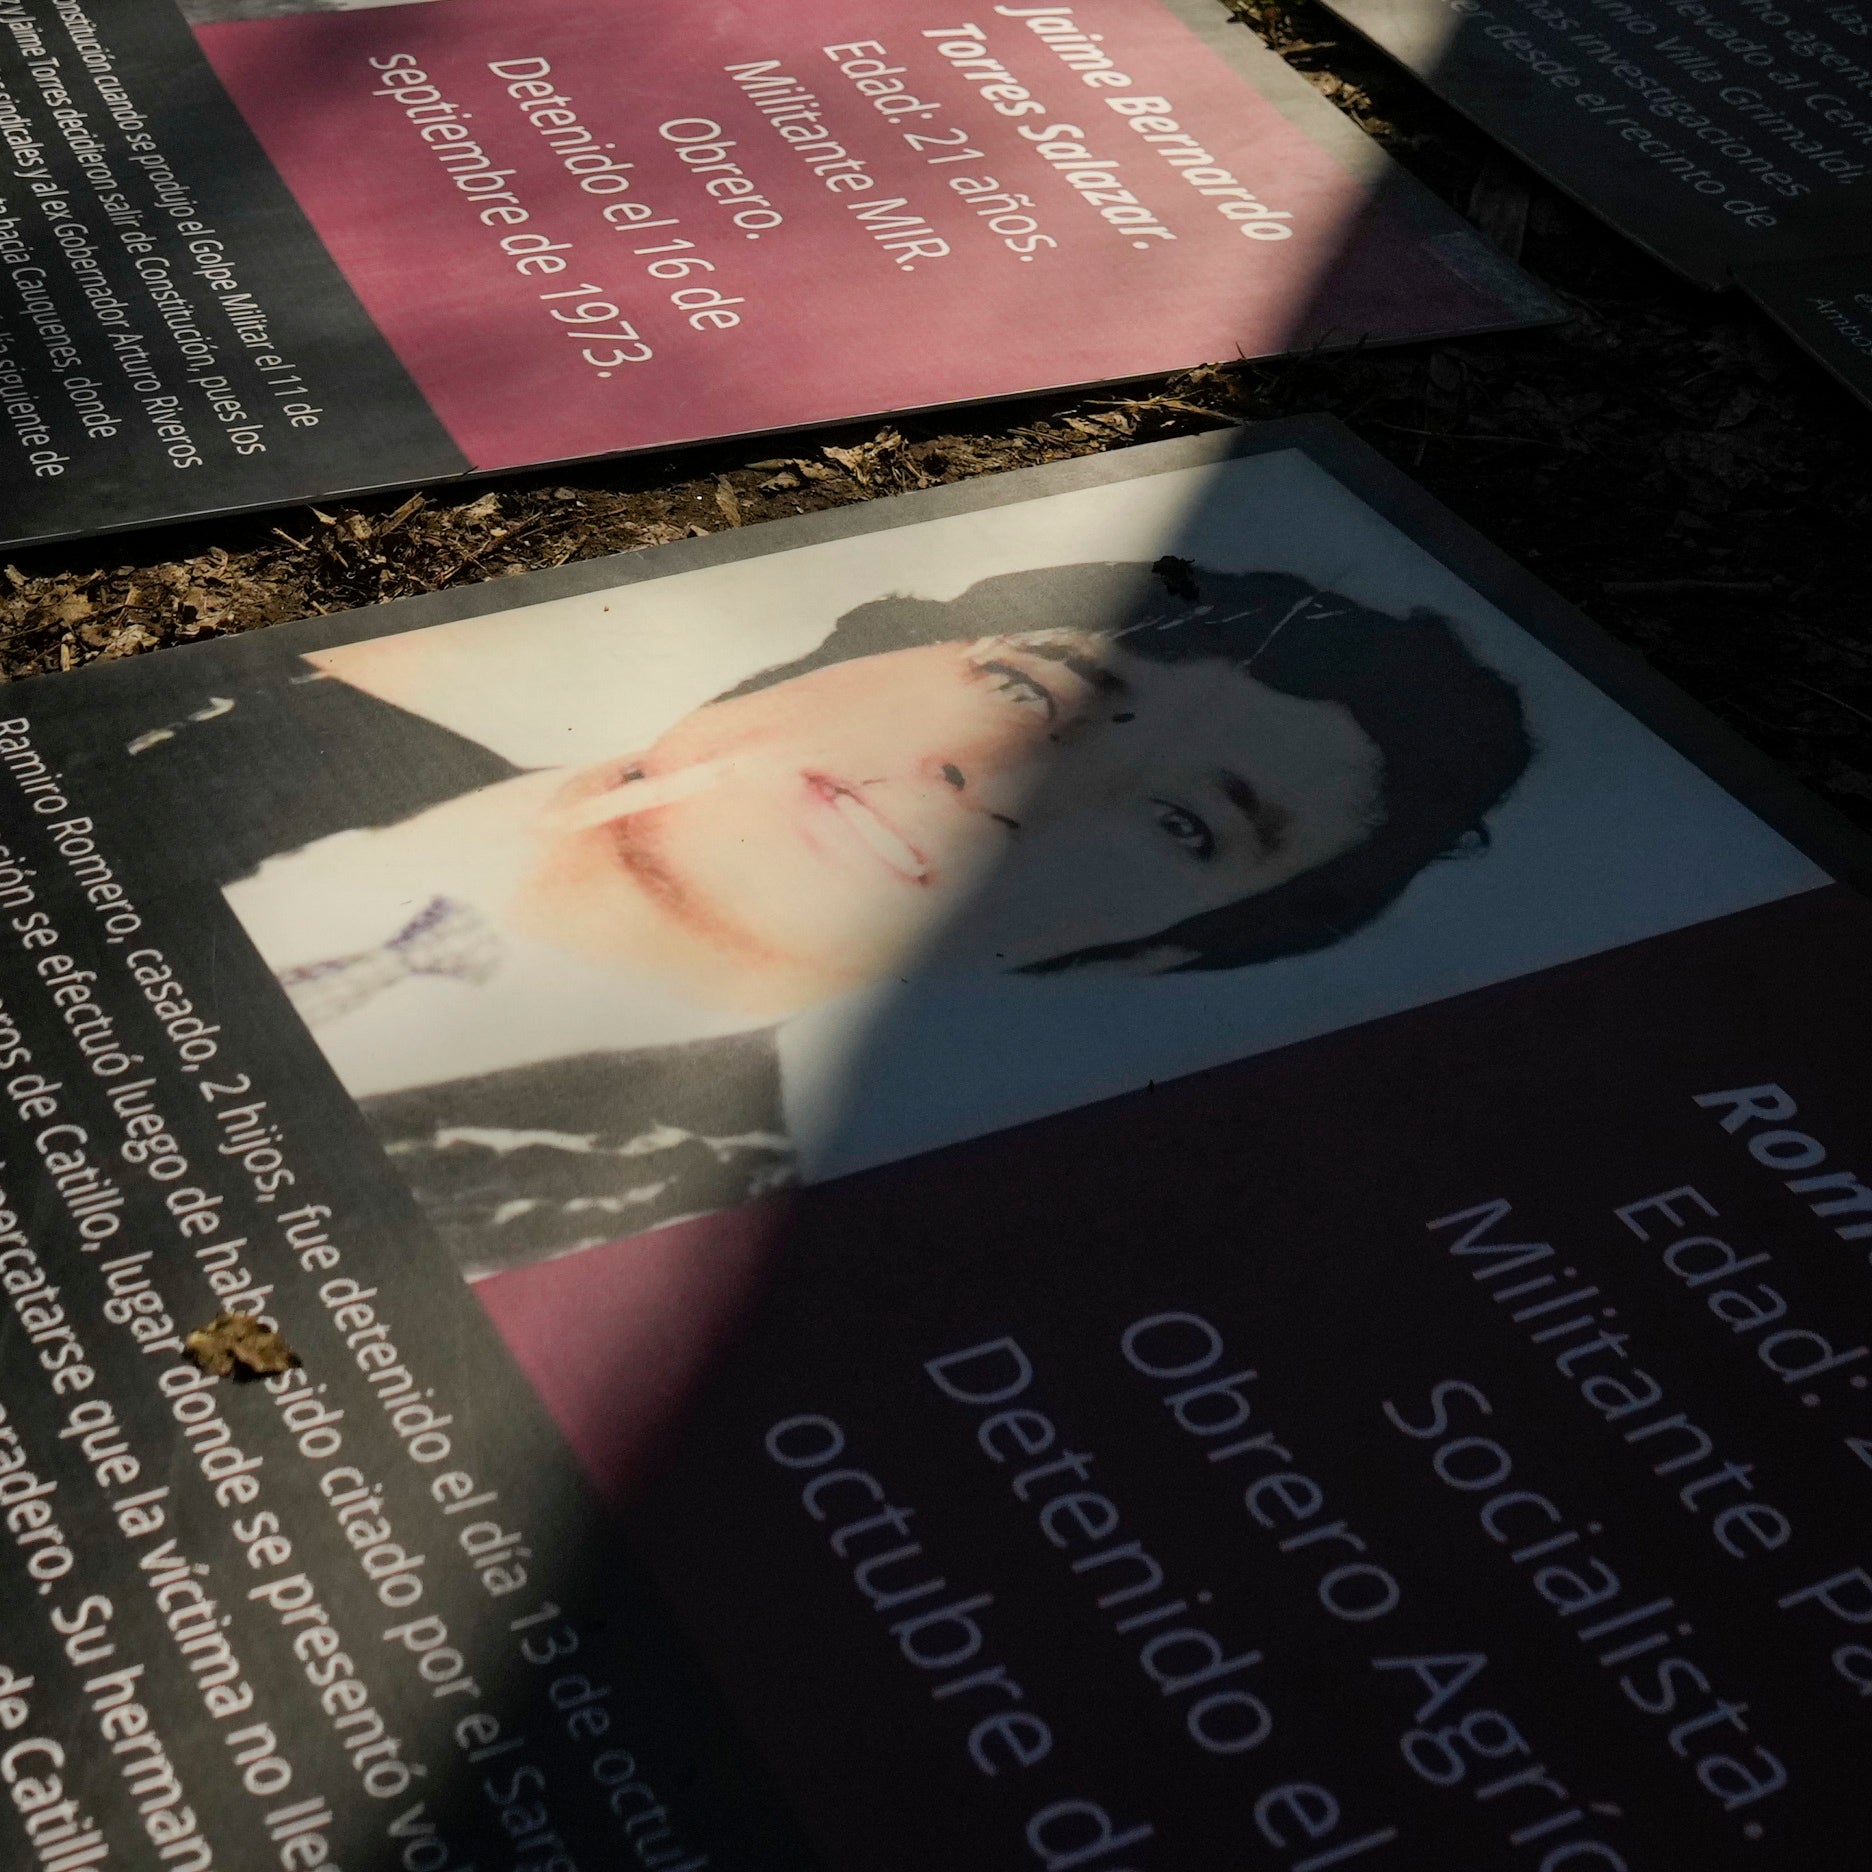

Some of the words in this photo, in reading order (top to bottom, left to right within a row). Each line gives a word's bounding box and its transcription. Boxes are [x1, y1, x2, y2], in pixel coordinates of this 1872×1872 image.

[488, 57, 634, 194] Detenido
[659, 118, 783, 239] Obrero.
[724, 60, 874, 192] Militante
[847, 198, 950, 271] MIR.
[823, 40, 941, 124] Edad:
[903, 128, 985, 164] 21
[949, 176, 1057, 262] años.
[922, 23, 1046, 116] Torres
[1017, 124, 1177, 249] Salazar.
[993, 5, 1131, 87] Jaime
[1105, 97, 1294, 240] Bernardo
[369, 54, 529, 226] septiembre
[500, 234, 573, 275] de
[539, 283, 653, 378] 1973.
[603, 203, 680, 231] el
[633, 239, 715, 278] 16
[671, 288, 745, 330] de
[46, 816, 142, 944] Romero,
[126, 948, 221, 1072] casado,
[7, 1074, 63, 1121] de
[199, 1073, 251, 1102] 2
[35, 1124, 124, 1251] Catillo,
[217, 1101, 295, 1202] hijos,
[277, 1204, 340, 1271] fue
[1613, 1184, 1870, 1408] Edad:
[100, 1251, 211, 1353] lugar
[319, 1278, 453, 1463] detenido
[1425, 1197, 1792, 1559] Militante
[158, 1365, 263, 1507] donde
[431, 1471, 498, 1515] el
[1121, 1311, 1401, 1621] Obrero
[232, 1511, 291, 1568] se
[459, 1521, 532, 1596] día
[510, 1602, 579, 1664] 13
[765, 1414, 1053, 1777] octubre
[1025, 1800, 1154, 1871] d
[923, 1336, 1272, 1754] Detenido
[1254, 1782, 1398, 1871] el
[1382, 1379, 1787, 1840] Socialista.
[248, 1573, 427, 1798] presentó
[549, 1675, 612, 1737] de
